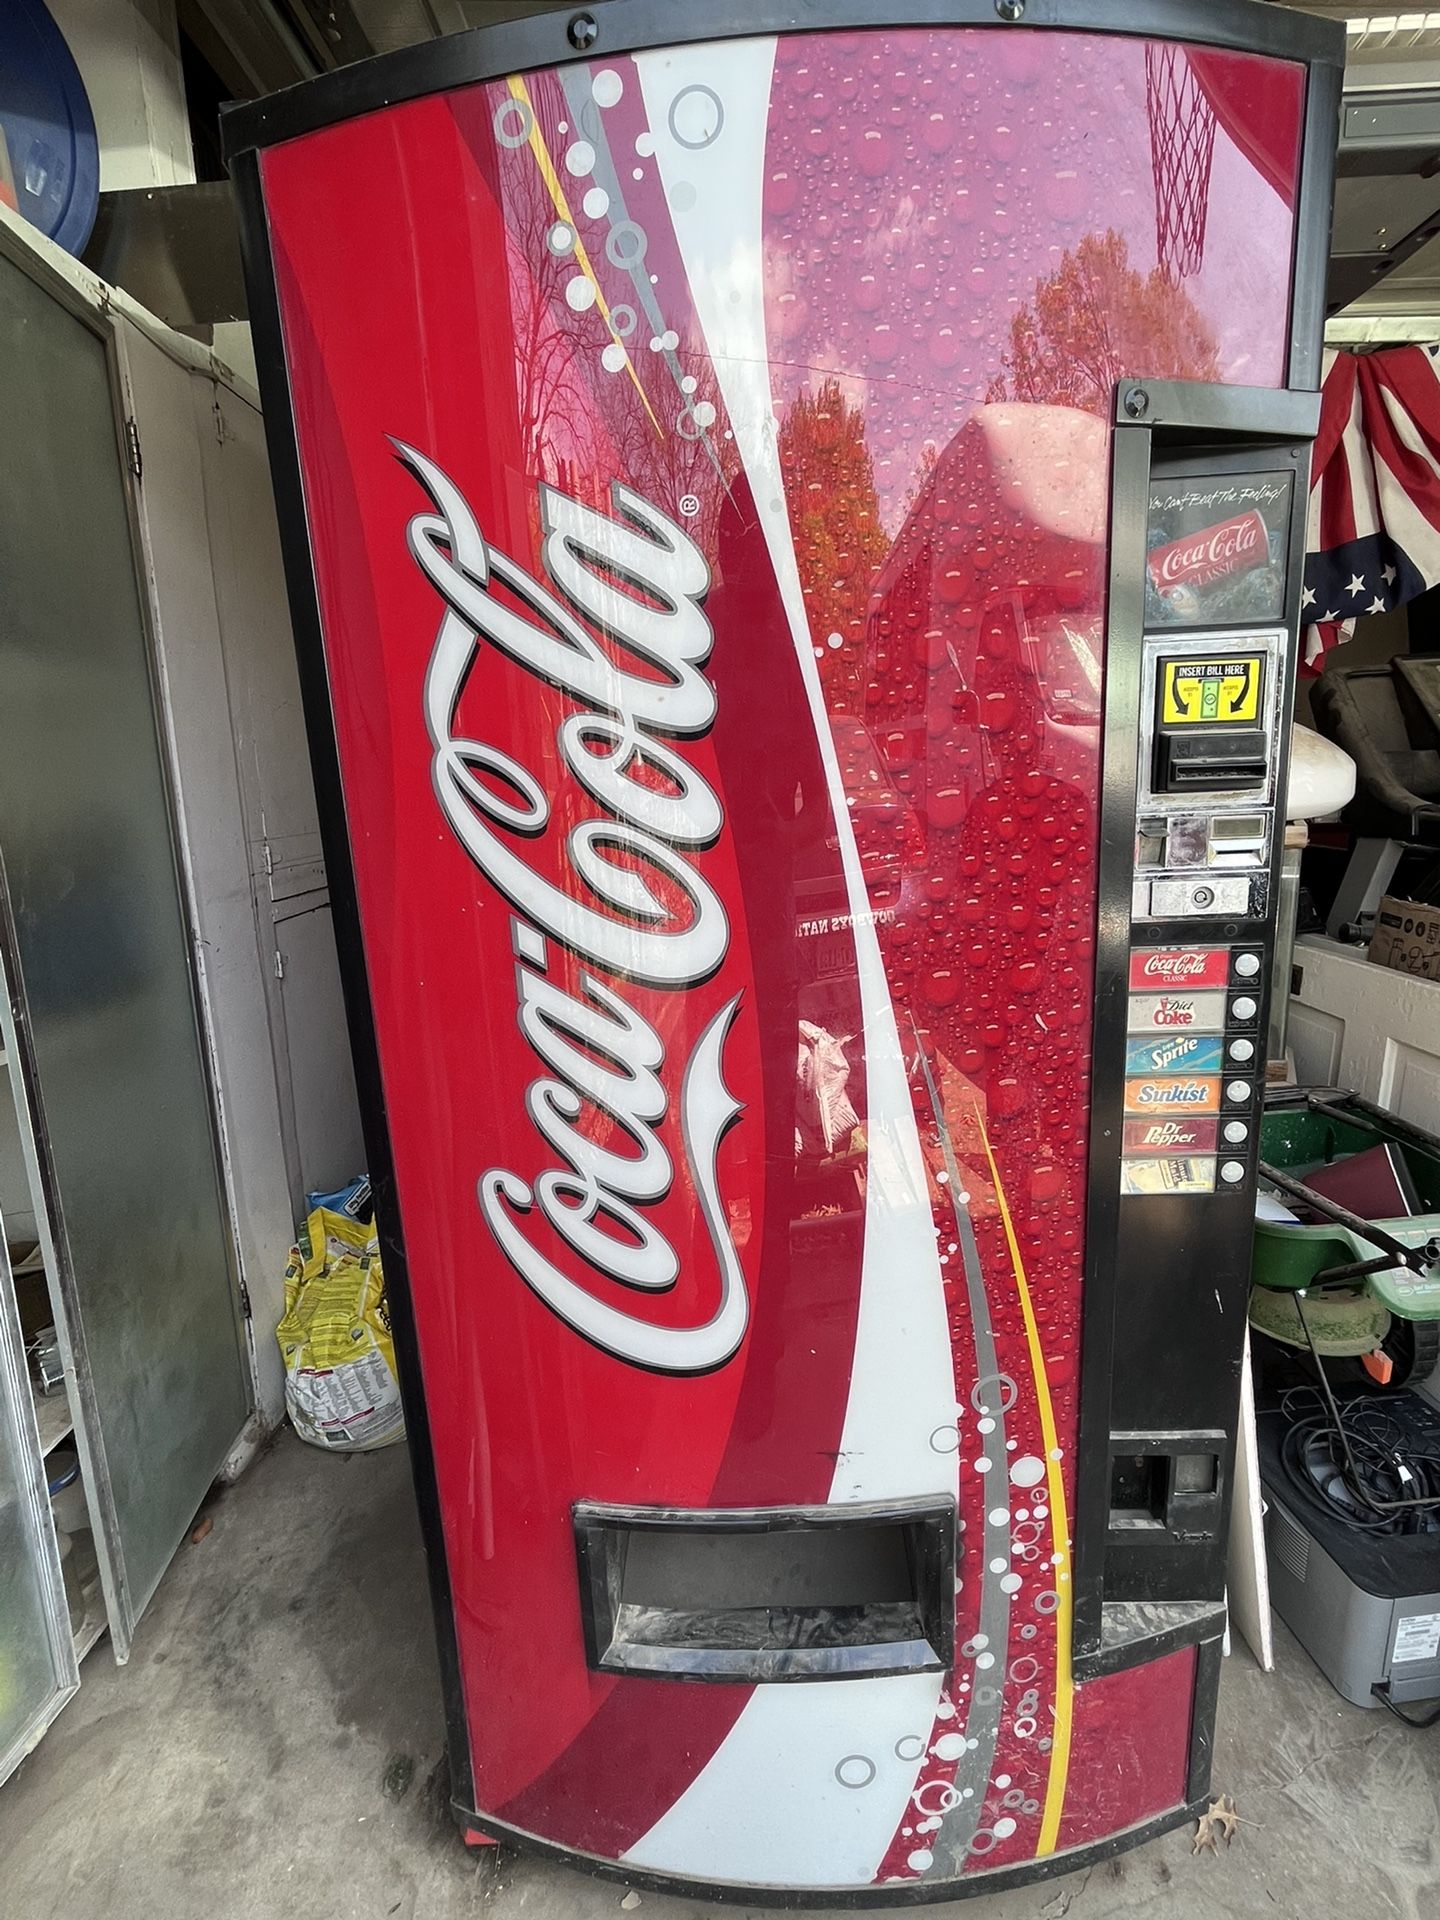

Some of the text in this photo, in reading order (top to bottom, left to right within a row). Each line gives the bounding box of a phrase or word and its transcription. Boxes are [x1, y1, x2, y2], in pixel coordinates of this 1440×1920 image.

[1188, 490, 1219, 508] Beat
[1217, 487, 1238, 504] The
[1162, 518, 1257, 580] Coca-Cola
[1188, 558, 1239, 586] CLASSIC
[1178, 664, 1245, 677] INSERT BILL HERE
[387, 435, 749, 1373] Coca-Cola
[1144, 953, 1208, 976] Coca-Cola
[1162, 974, 1188, 982] CLASSIC
[1168, 1000, 1194, 1011] Diet
[1153, 1009, 1193, 1025] Coke
[1151, 1038, 1198, 1070] Sprite
[1138, 1083, 1209, 1102] Sunkist
[1162, 1122, 1183, 1135] Dr
